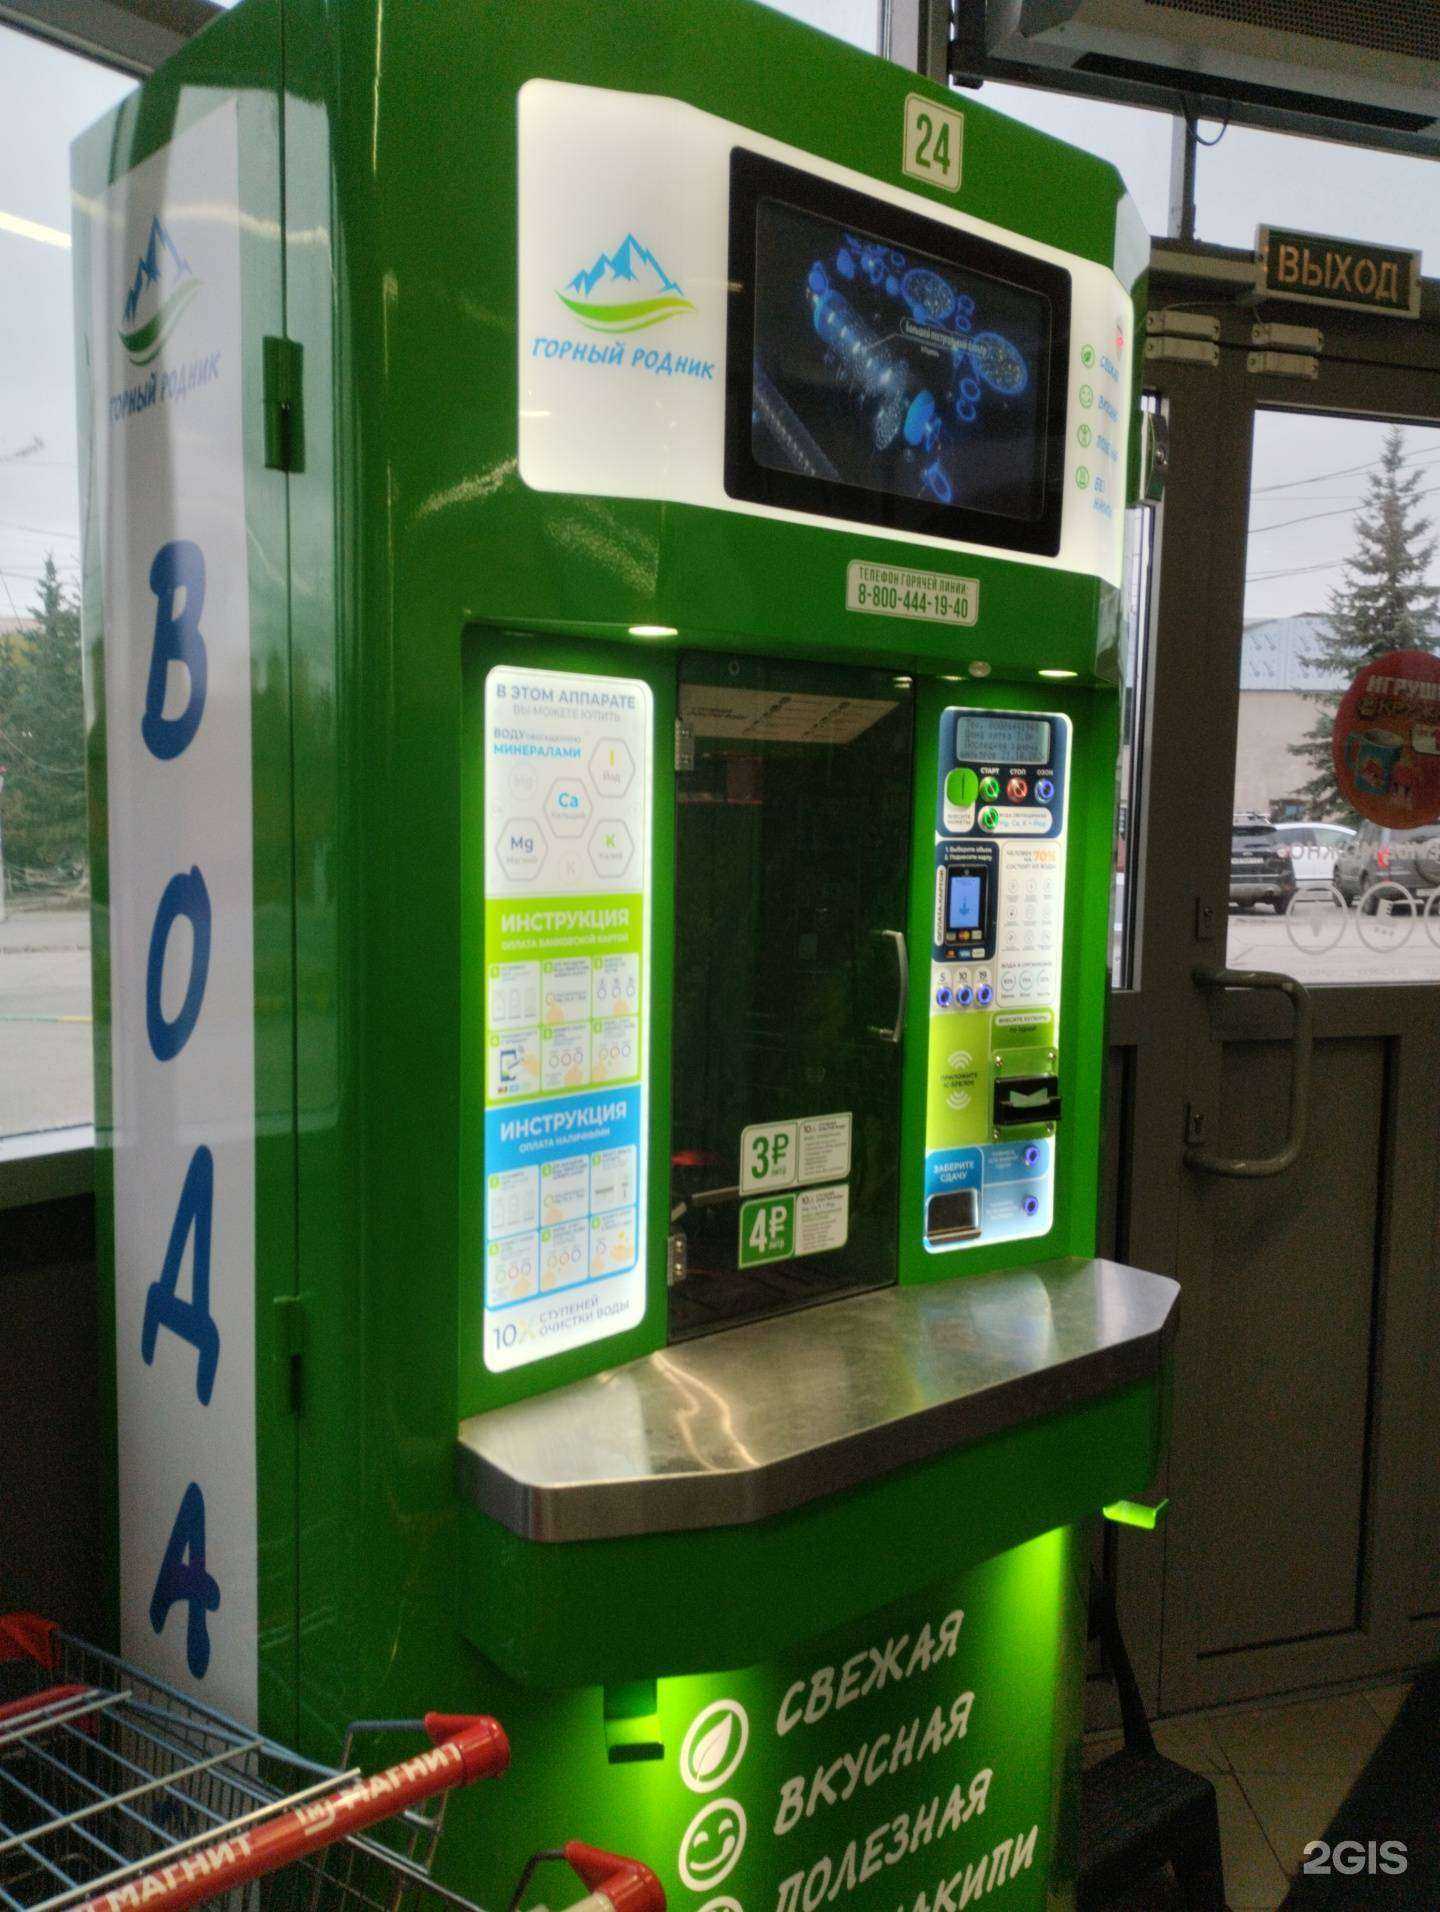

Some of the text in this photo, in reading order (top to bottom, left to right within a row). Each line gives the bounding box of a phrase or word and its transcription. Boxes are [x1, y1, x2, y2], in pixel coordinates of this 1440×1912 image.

[916, 113, 950, 175] 24
[1277, 243, 1399, 302] ВЫХОД
[531, 336, 715, 379] ГОРНЫЙ РОДНИК
[858, 566, 899, 585] ТЕЛЕФОН
[901, 573, 938, 591] ГОРЯЧЕЙ
[858, 583, 969, 618] 8-800-444-19-40
[496, 683, 636, 710] В ЭТОМ АППАРАТЕ
[494, 727, 525, 741] ВОДУ
[494, 742, 581, 759] МИНЕРАЛАМИ
[558, 792, 579, 808] Ca
[510, 837, 534, 853] Mg
[502, 908, 630, 932] ИНСТРУКЦИЯ
[141, 539, 221, 1680] ВОДА
[500, 1101, 627, 1142] ИНСТРУКЦИЯ
[540, 1294, 599, 1322] СТУПЕНЕЙ
[493, 1323, 517, 1350] 10
[775, 1609, 965, 1737] СВЕЖАЯ
[341, 1742, 462, 1810] МАГНИТ
[773, 1691, 975, 1836] ВКУСНАЯ
[776, 1768, 994, 1912] ПОЛЕЗНАЯ
[106, 1833, 251, 1912] МАГНИТ
[897, 1825, 1039, 1912] КИПИ
